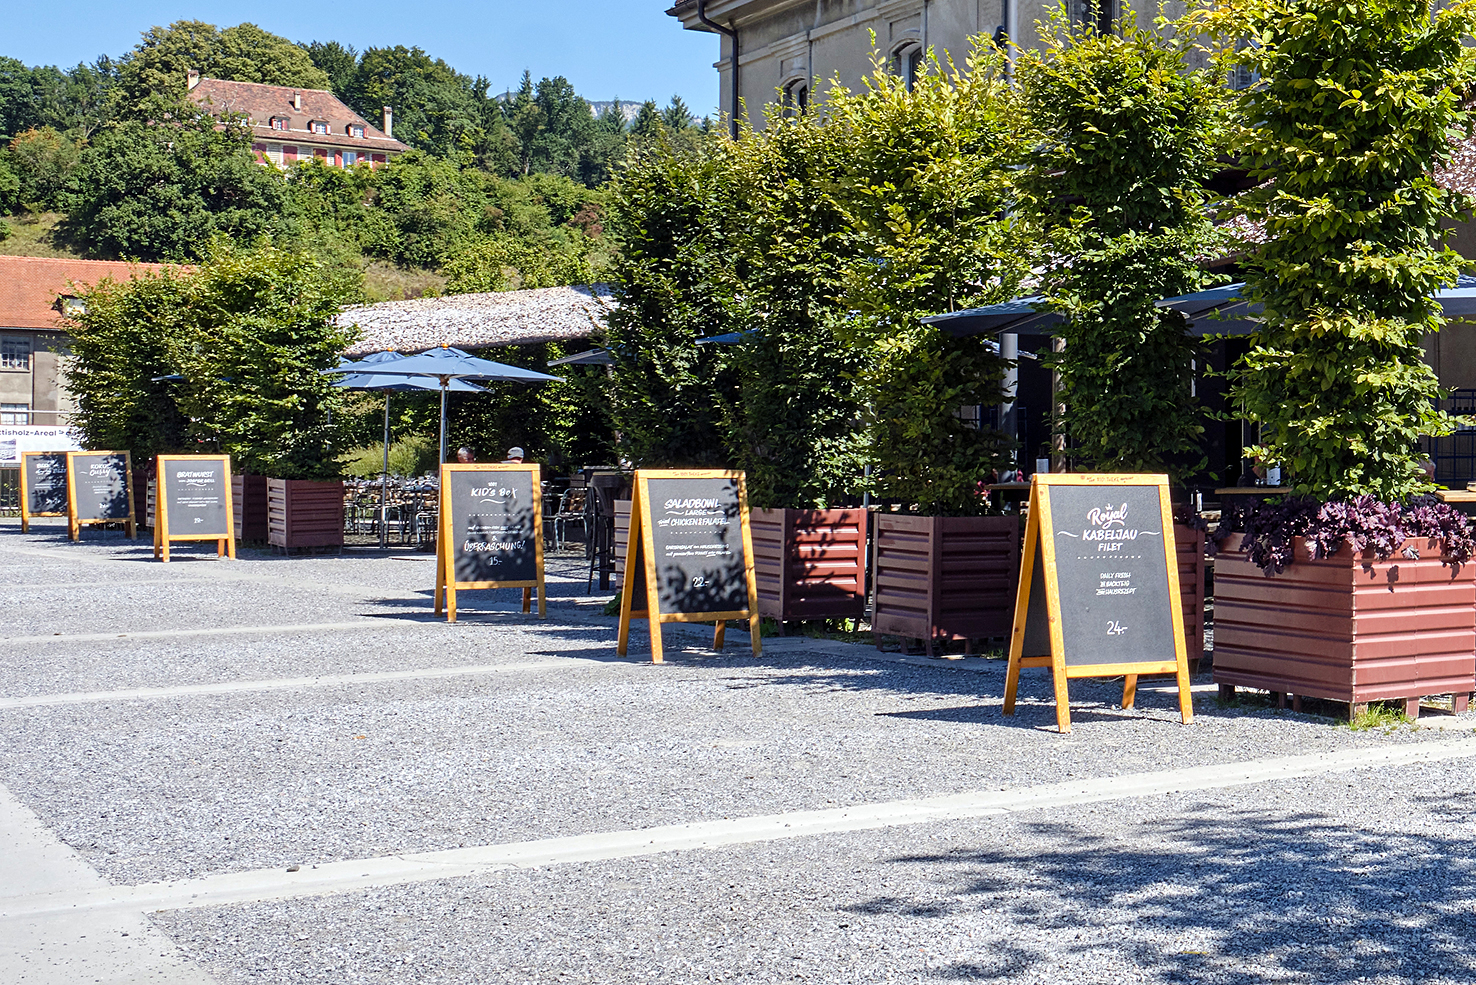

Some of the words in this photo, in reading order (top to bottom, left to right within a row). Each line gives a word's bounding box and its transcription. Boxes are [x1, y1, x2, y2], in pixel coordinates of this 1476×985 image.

[663, 498, 722, 510] SALADBOWL
[1086, 502, 1129, 530] Royal
[1082, 528, 1138, 541] KABELJAU
[1097, 542, 1123, 552] FILET
